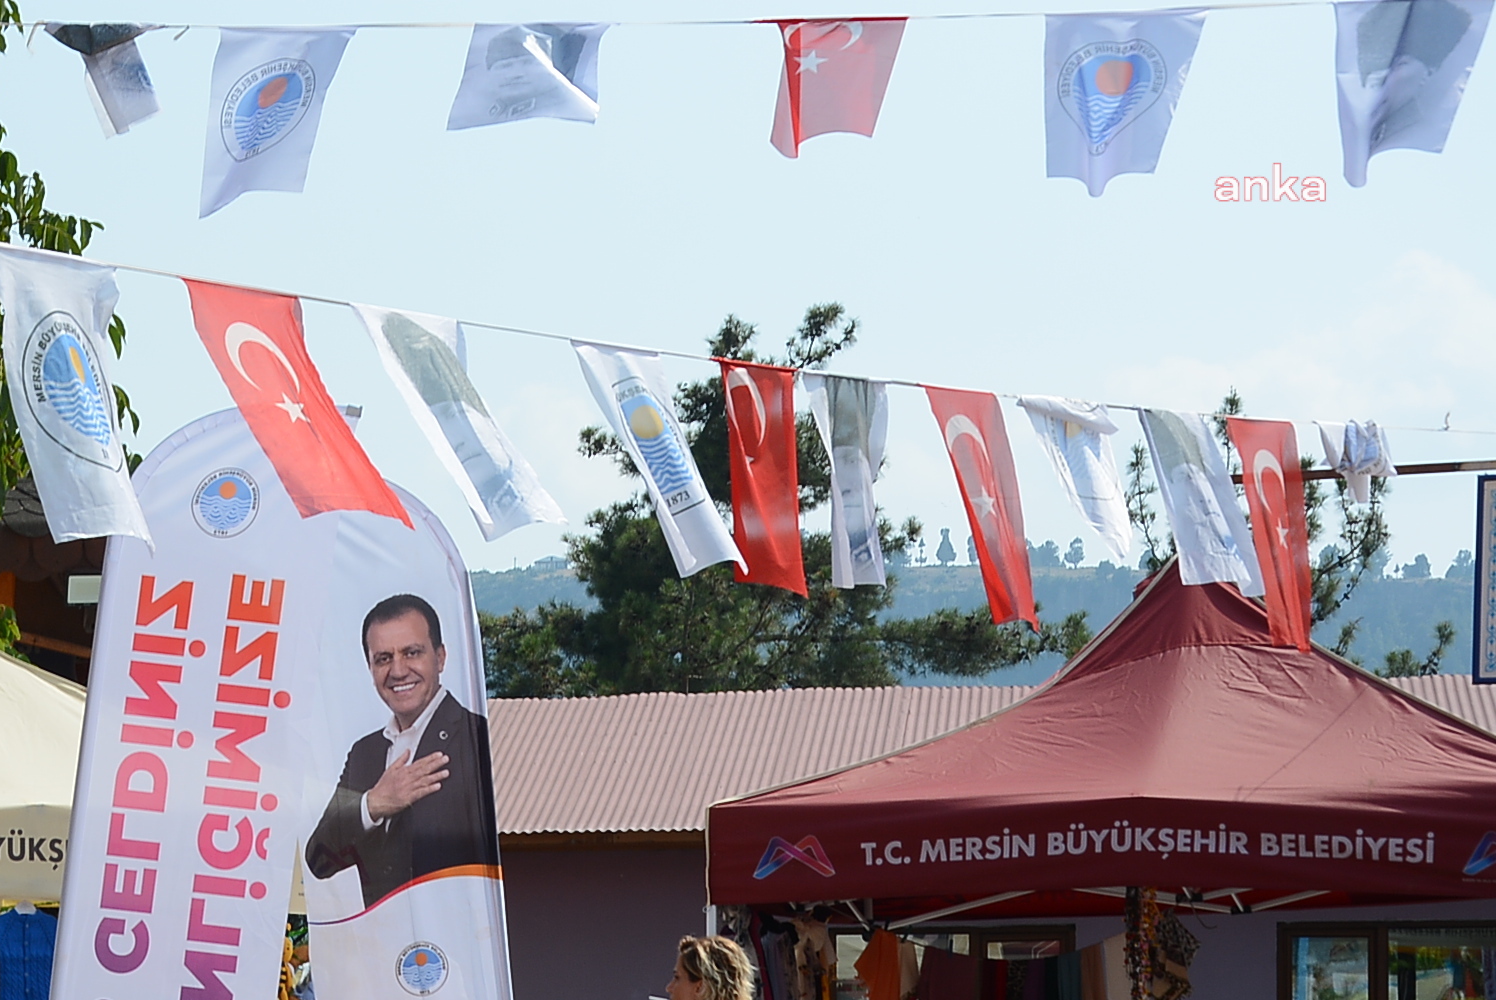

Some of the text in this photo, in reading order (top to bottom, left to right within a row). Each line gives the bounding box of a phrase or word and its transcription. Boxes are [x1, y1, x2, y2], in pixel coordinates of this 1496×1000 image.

[31, 352, 47, 404] MERSİN
[666, 490, 691, 508] 1873
[860, 820, 1435, 866] T.C. MERSİN BÜYÜKŞEHİR BELEDİYESİ
